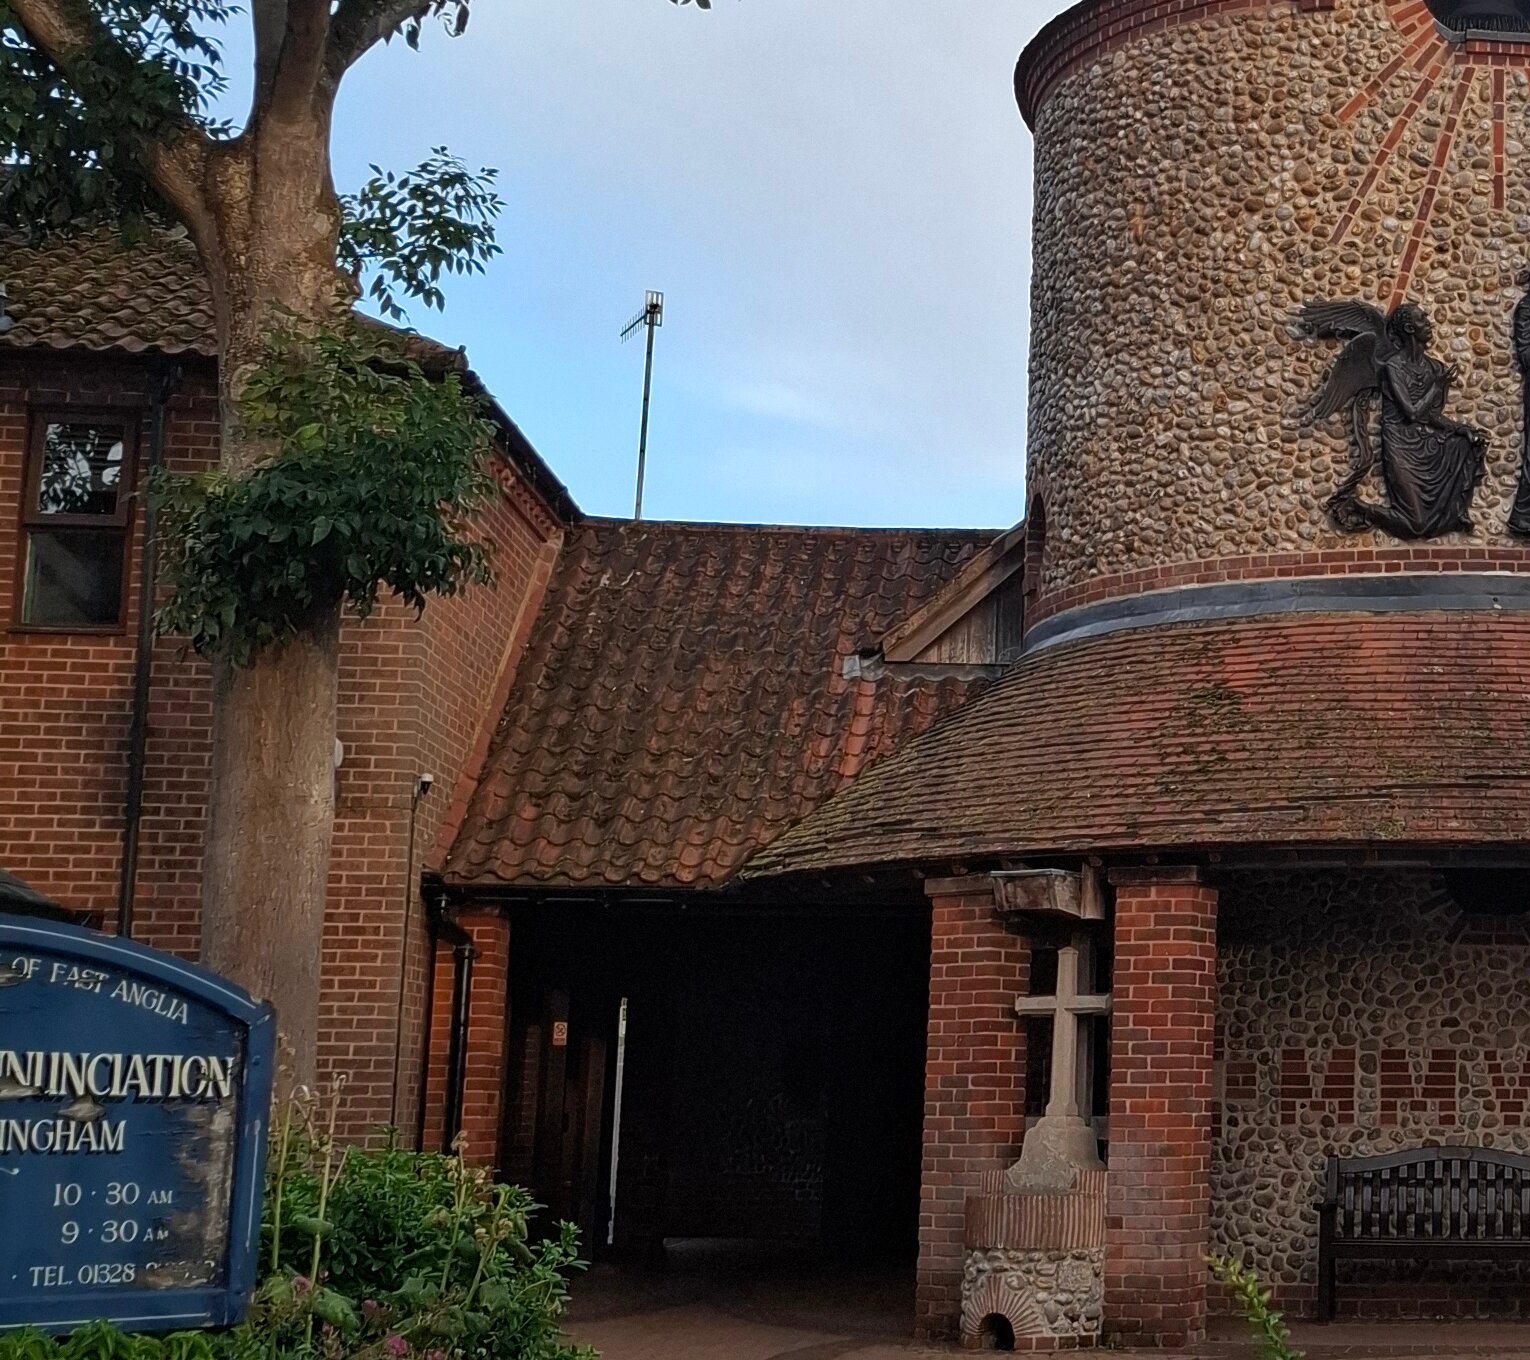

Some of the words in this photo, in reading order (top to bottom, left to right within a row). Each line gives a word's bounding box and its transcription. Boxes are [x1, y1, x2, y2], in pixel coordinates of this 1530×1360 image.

[11, 956, 42, 979] OF
[110, 979, 188, 1025] ANGLIA
[0, 1050, 235, 1098] NUNCIATION
[147, 1189, 173, 1205] AM
[78, 1263, 136, 1285] 01328
